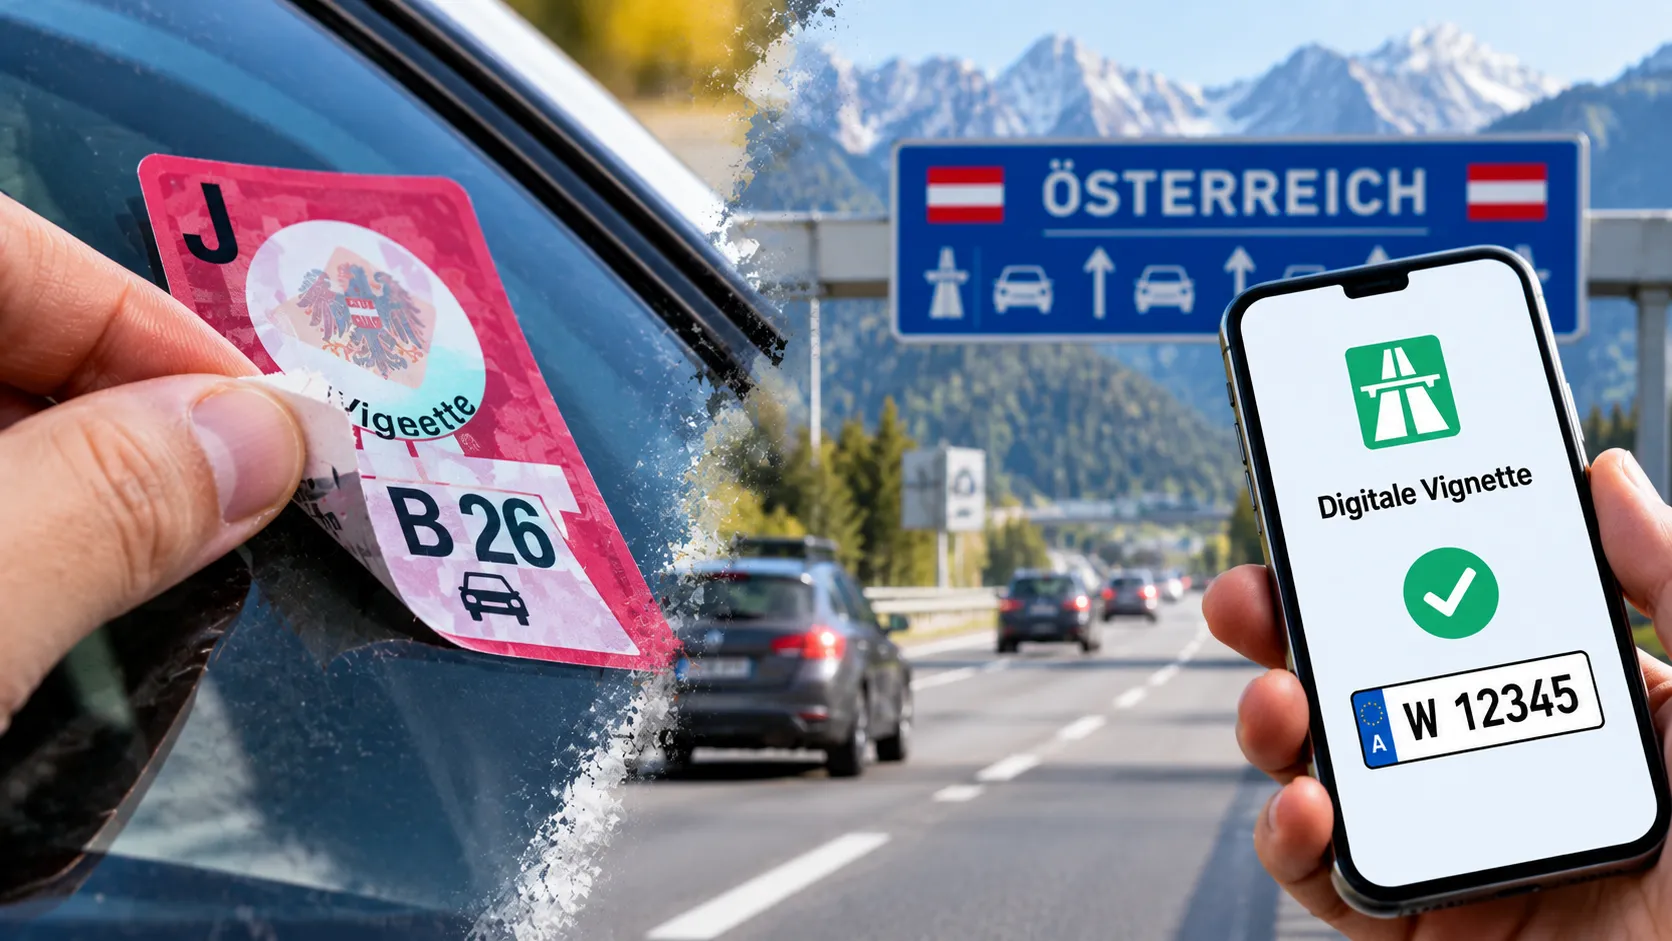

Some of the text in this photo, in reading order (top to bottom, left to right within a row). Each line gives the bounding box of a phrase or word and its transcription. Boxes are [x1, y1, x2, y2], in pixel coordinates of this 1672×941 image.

[1042, 159, 1426, 217] ÖSTERREICH
[182, 182, 239, 265] J
[1317, 466, 1533, 521] Digitale Vignette
[386, 486, 454, 557] B
[459, 493, 556, 569] 26
[1402, 673, 1579, 741] W 12345
[1372, 734, 1388, 753] A
